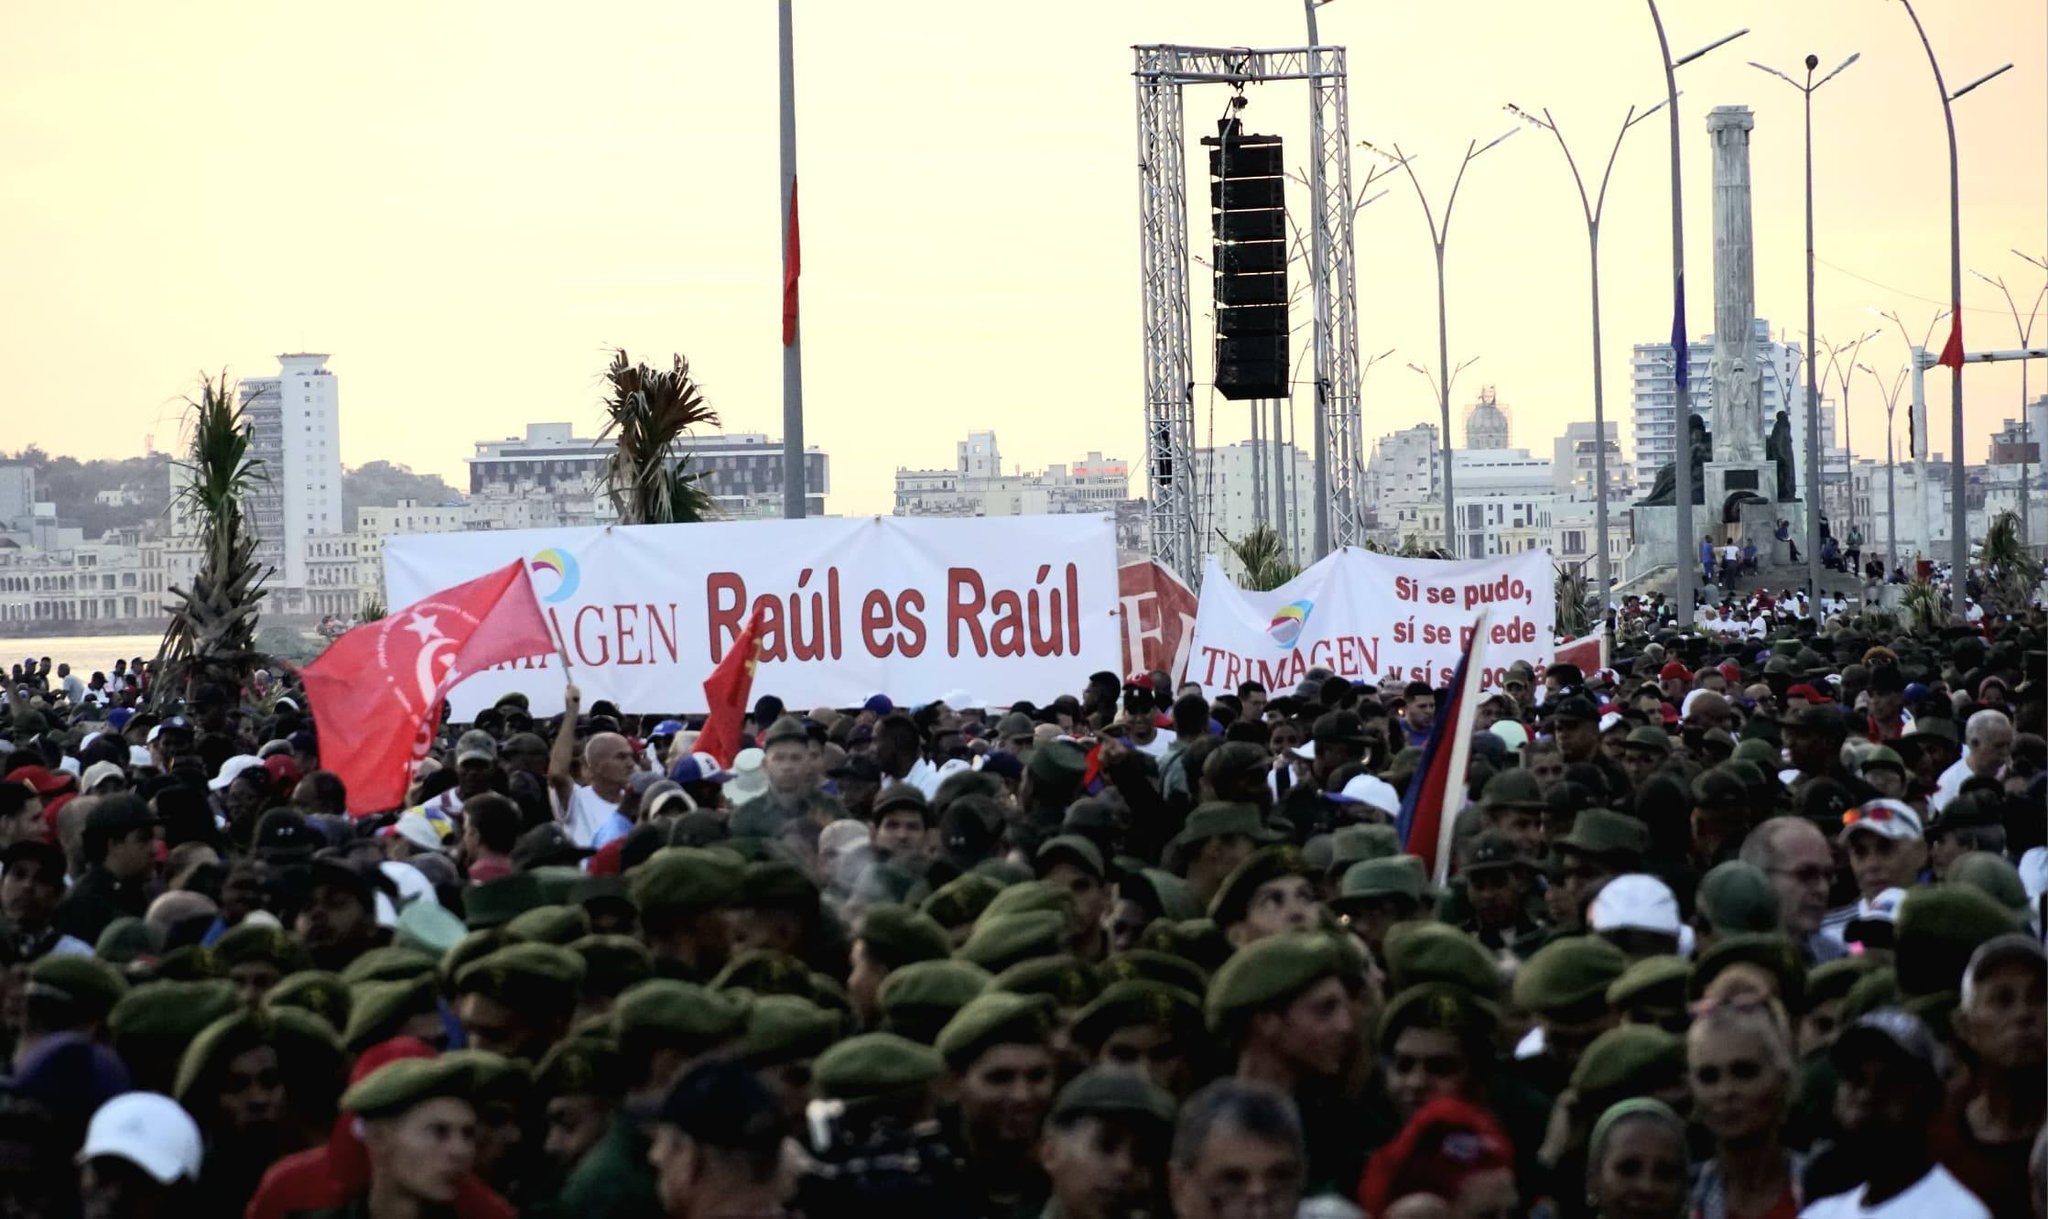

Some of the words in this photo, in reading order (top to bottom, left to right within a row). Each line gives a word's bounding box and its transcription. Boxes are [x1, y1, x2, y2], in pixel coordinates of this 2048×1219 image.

[1427, 586, 1456, 604] se
[1464, 574, 1532, 611] pudo,
[707, 566, 842, 664] Raúl
[861, 588, 927, 658] es
[947, 562, 1080, 658] Raúl
[1393, 615, 1415, 643] sí
[1423, 623, 1452, 644] se
[1460, 615, 1536, 654] pede
[1201, 636, 1380, 694] TRIMAGEN
[1480, 657, 1546, 694] poá
